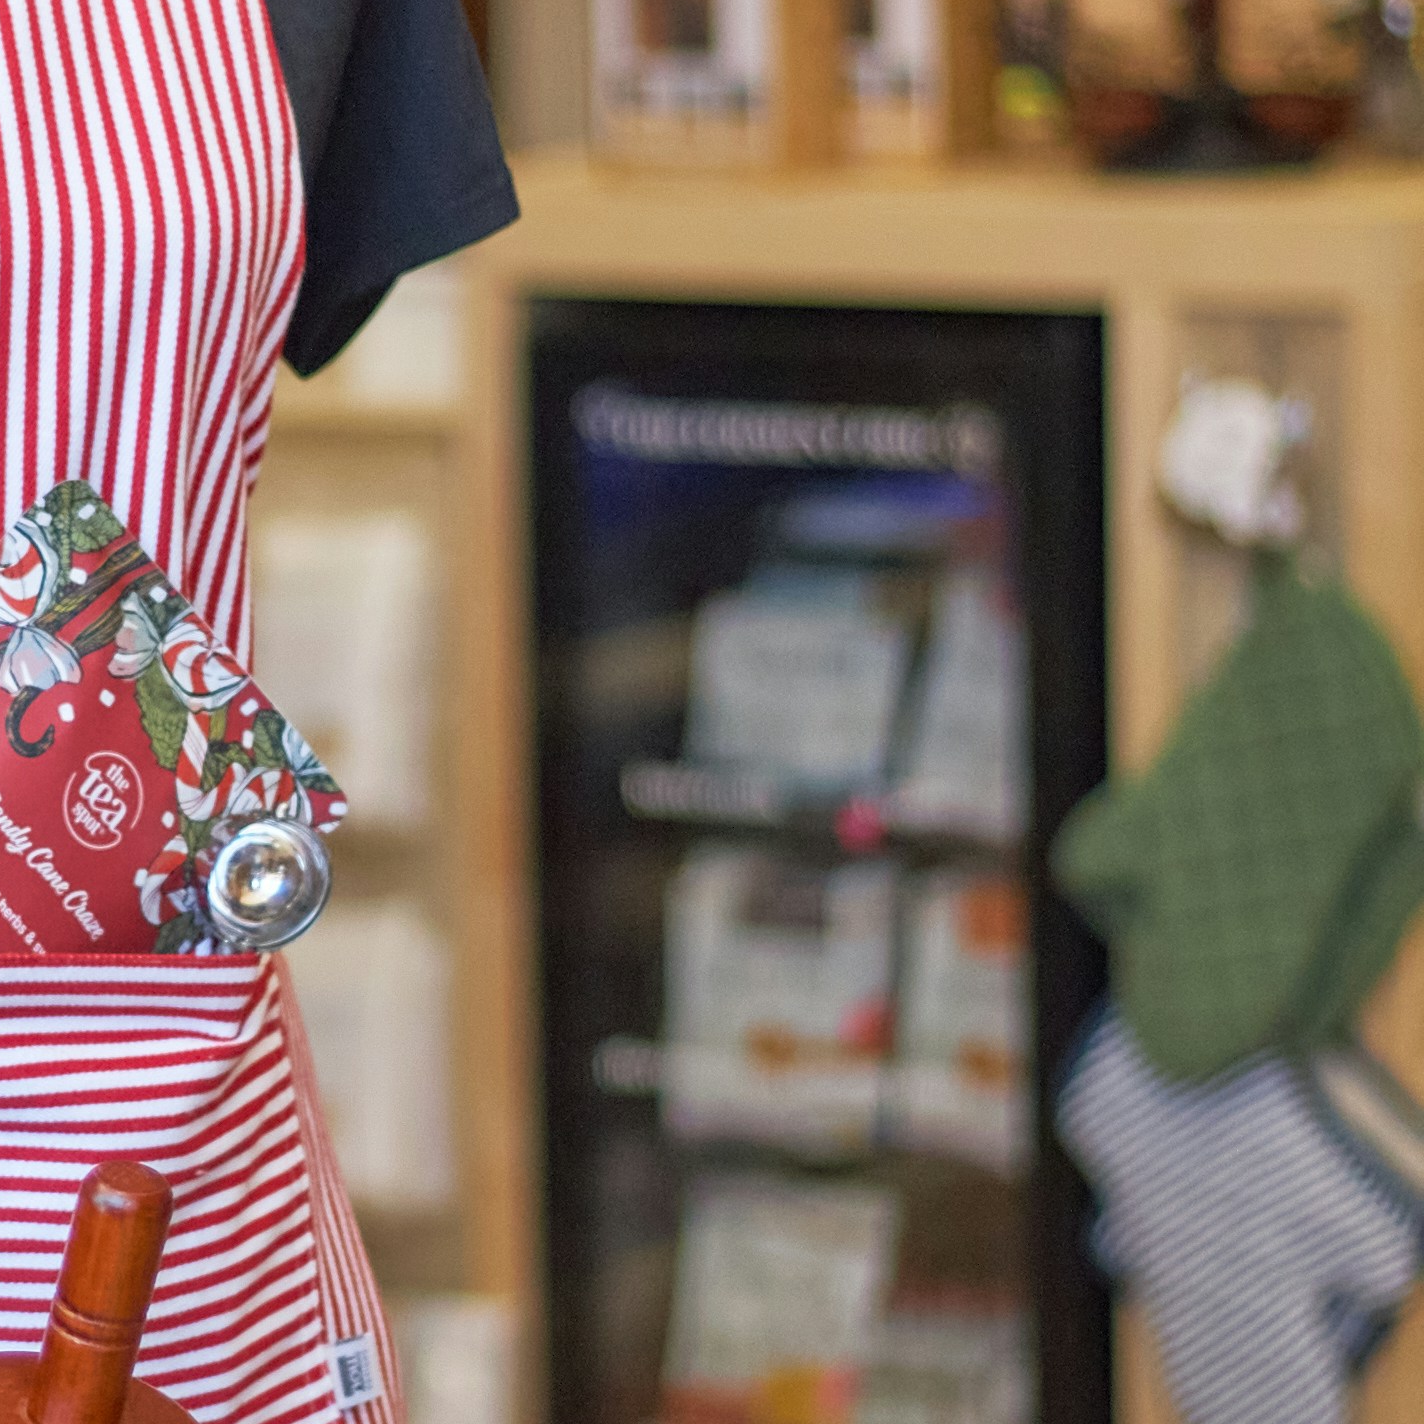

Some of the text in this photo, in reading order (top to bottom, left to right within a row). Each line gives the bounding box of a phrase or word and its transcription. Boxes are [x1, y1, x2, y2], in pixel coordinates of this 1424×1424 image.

[106, 763, 130, 791] the
[79, 769, 127, 830] tea
[27, 848, 70, 895] Cane
[63, 890, 104, 941] Craze
[25, 931, 37, 945] &
